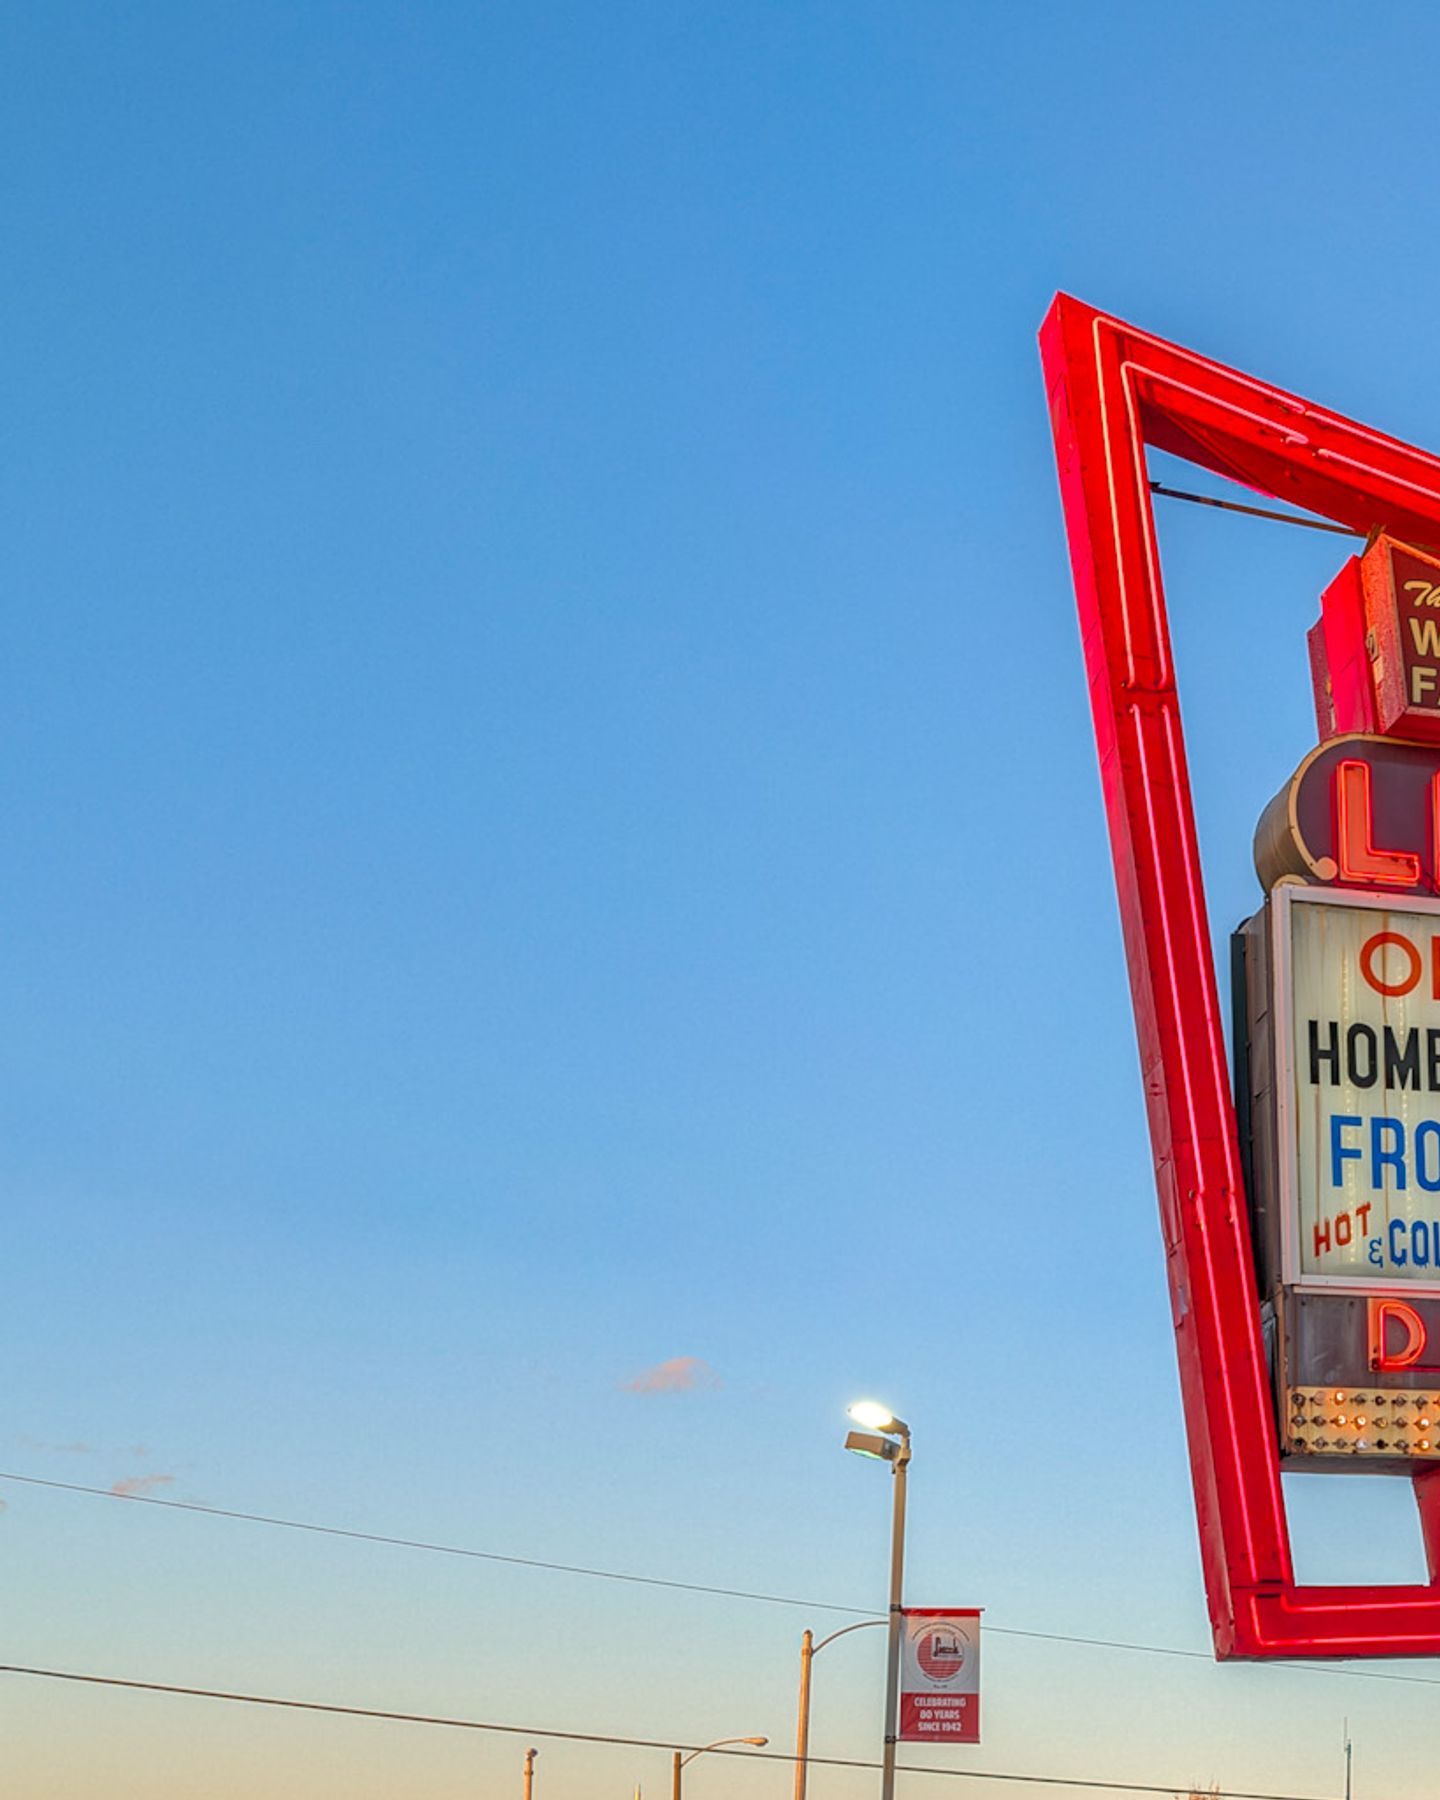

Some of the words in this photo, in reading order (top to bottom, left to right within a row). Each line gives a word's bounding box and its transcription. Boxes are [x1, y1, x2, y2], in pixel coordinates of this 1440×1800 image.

[1313, 1202, 1371, 1257] HOT
[934, 1710, 960, 1720] YEARS
[918, 1721, 940, 1731] SINCE
